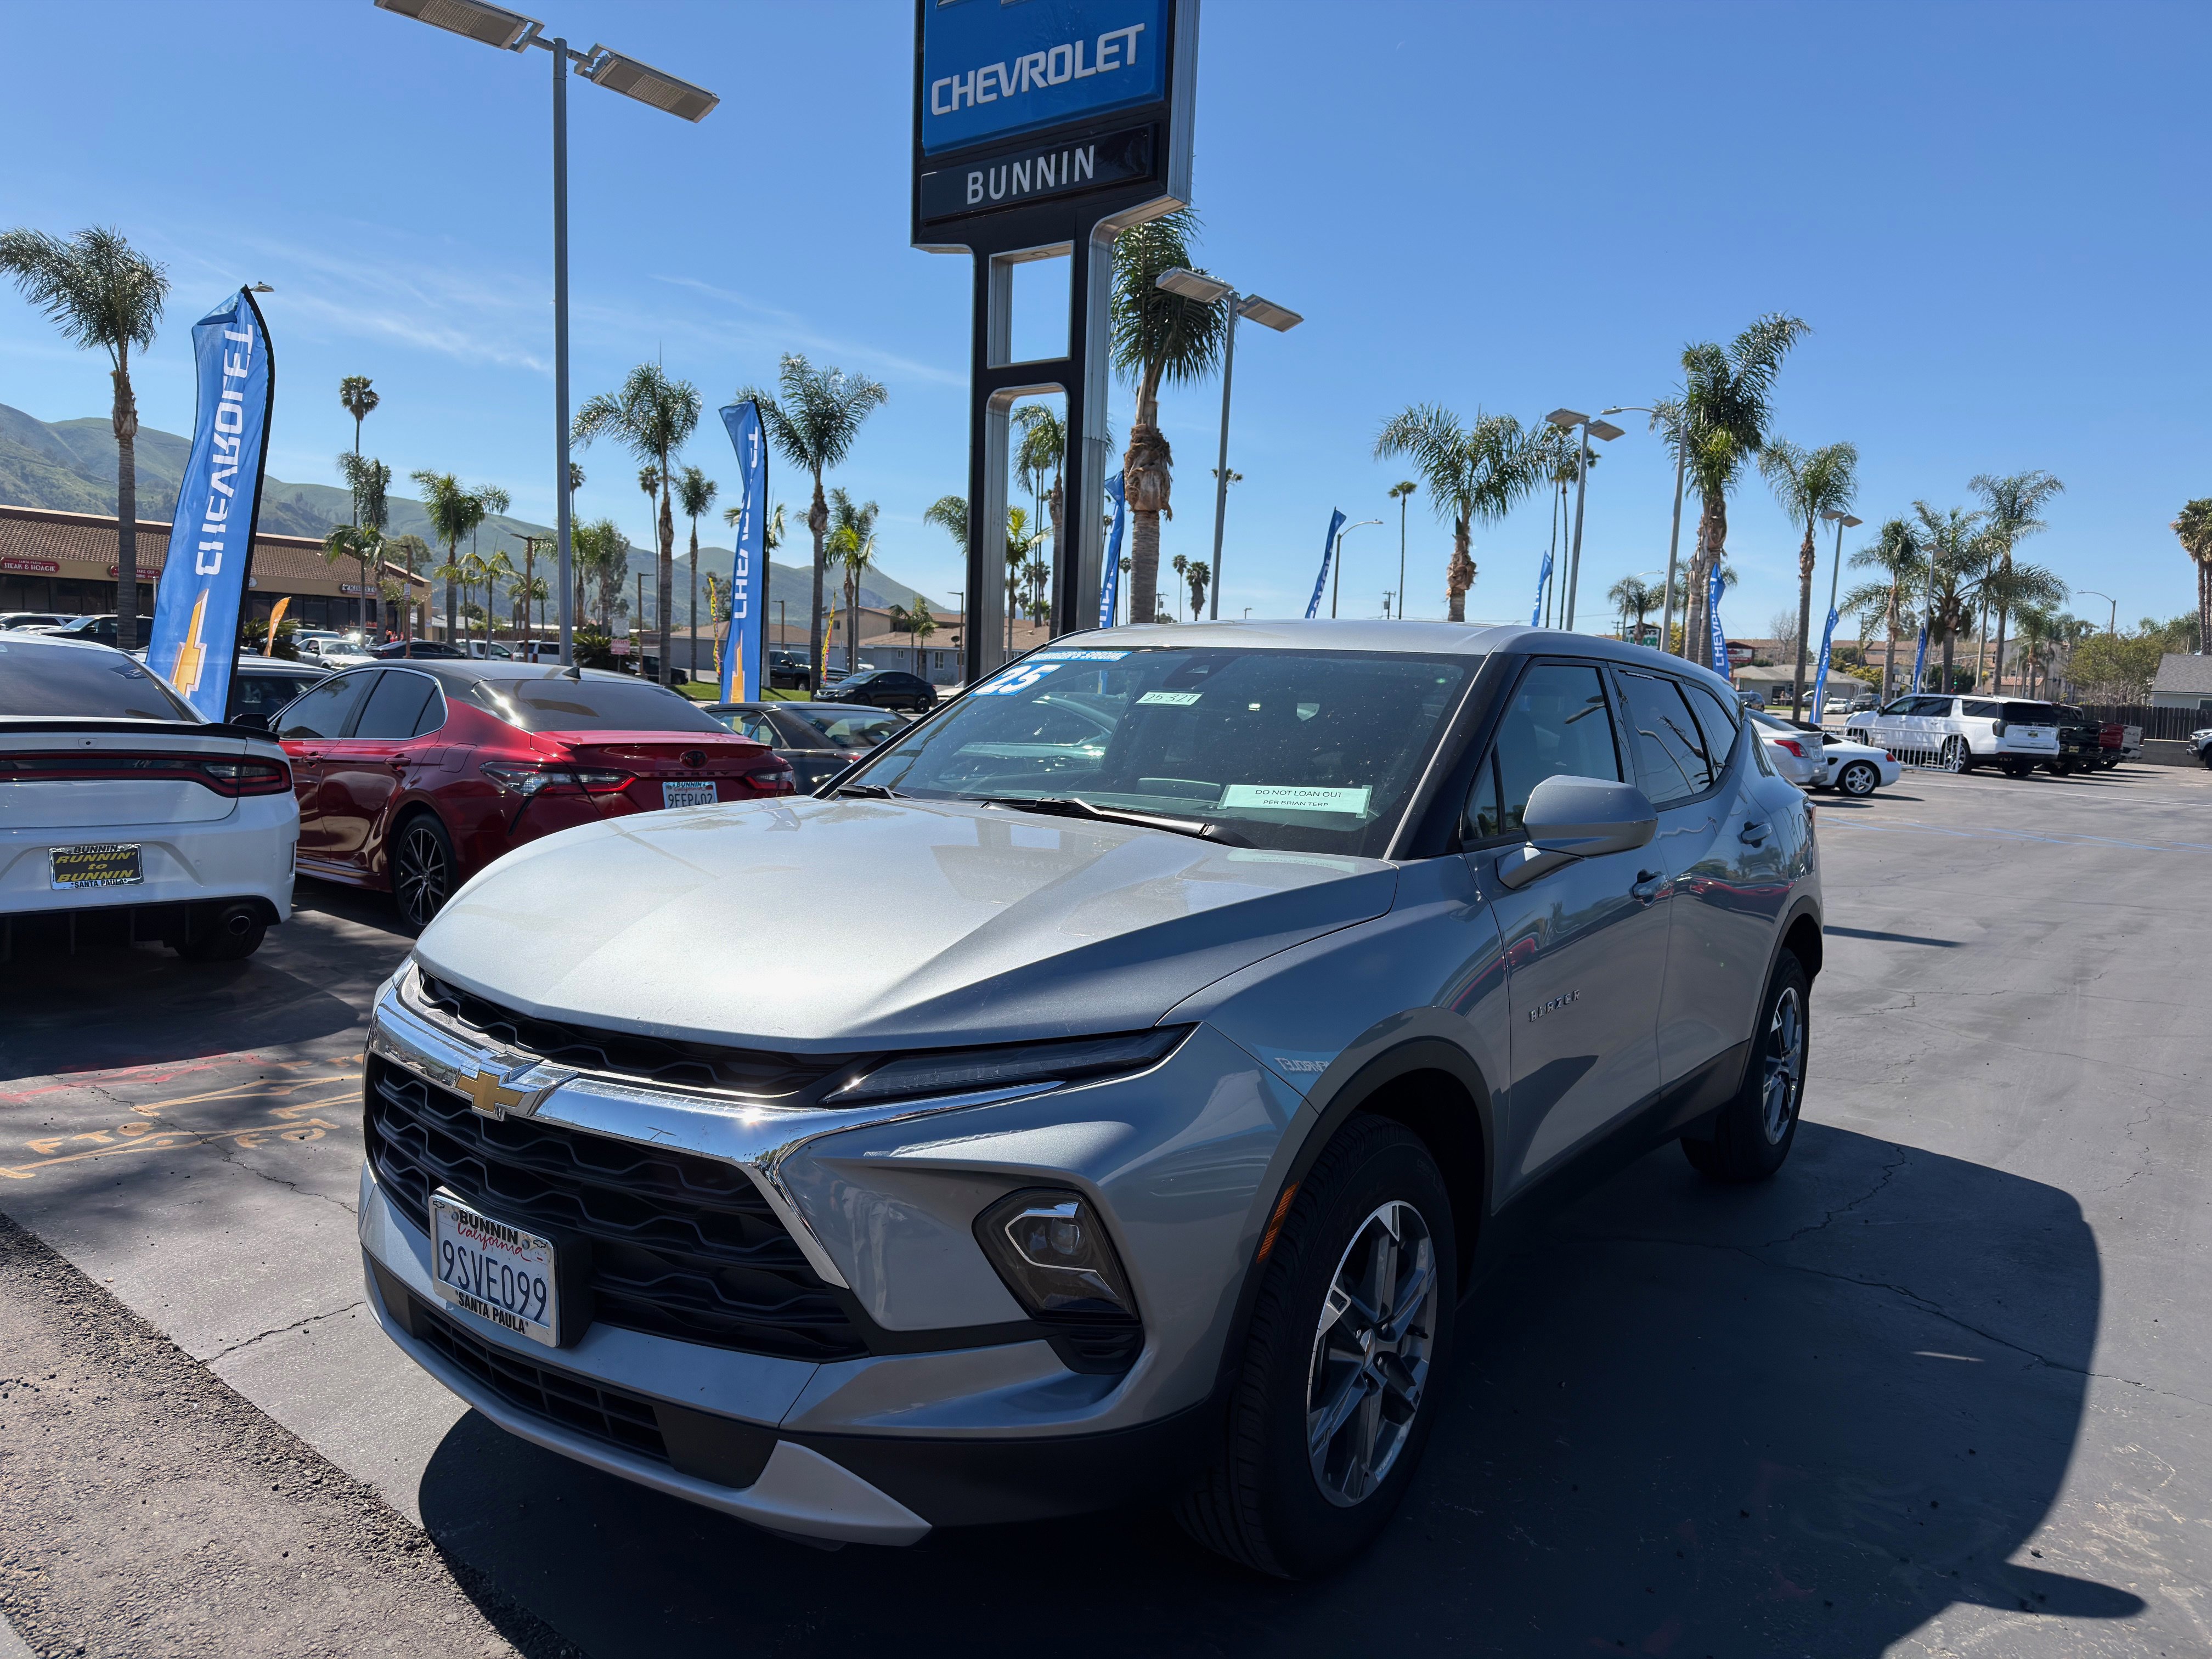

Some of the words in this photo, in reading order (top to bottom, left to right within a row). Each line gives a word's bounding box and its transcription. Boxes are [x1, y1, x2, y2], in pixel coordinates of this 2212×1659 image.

[931, 22, 1145, 115] CHEVROLET
[967, 145, 1094, 205] BUNNIN
[974, 664, 1063, 694] 25
[668, 793, 713, 808] 9FEP402
[55, 852, 136, 864] RUNNIN'
[74, 845, 118, 854] BUNNIN
[56, 870, 134, 882] BUNNIN
[1528, 990, 1580, 1023] BLAZER
[458, 1222, 532, 1262] California
[459, 1208, 518, 1245] BUNNIN
[443, 1240, 546, 1322] 9SVE099
[459, 1293, 489, 1318] SANTA
[493, 1308, 526, 1334] PAULA
